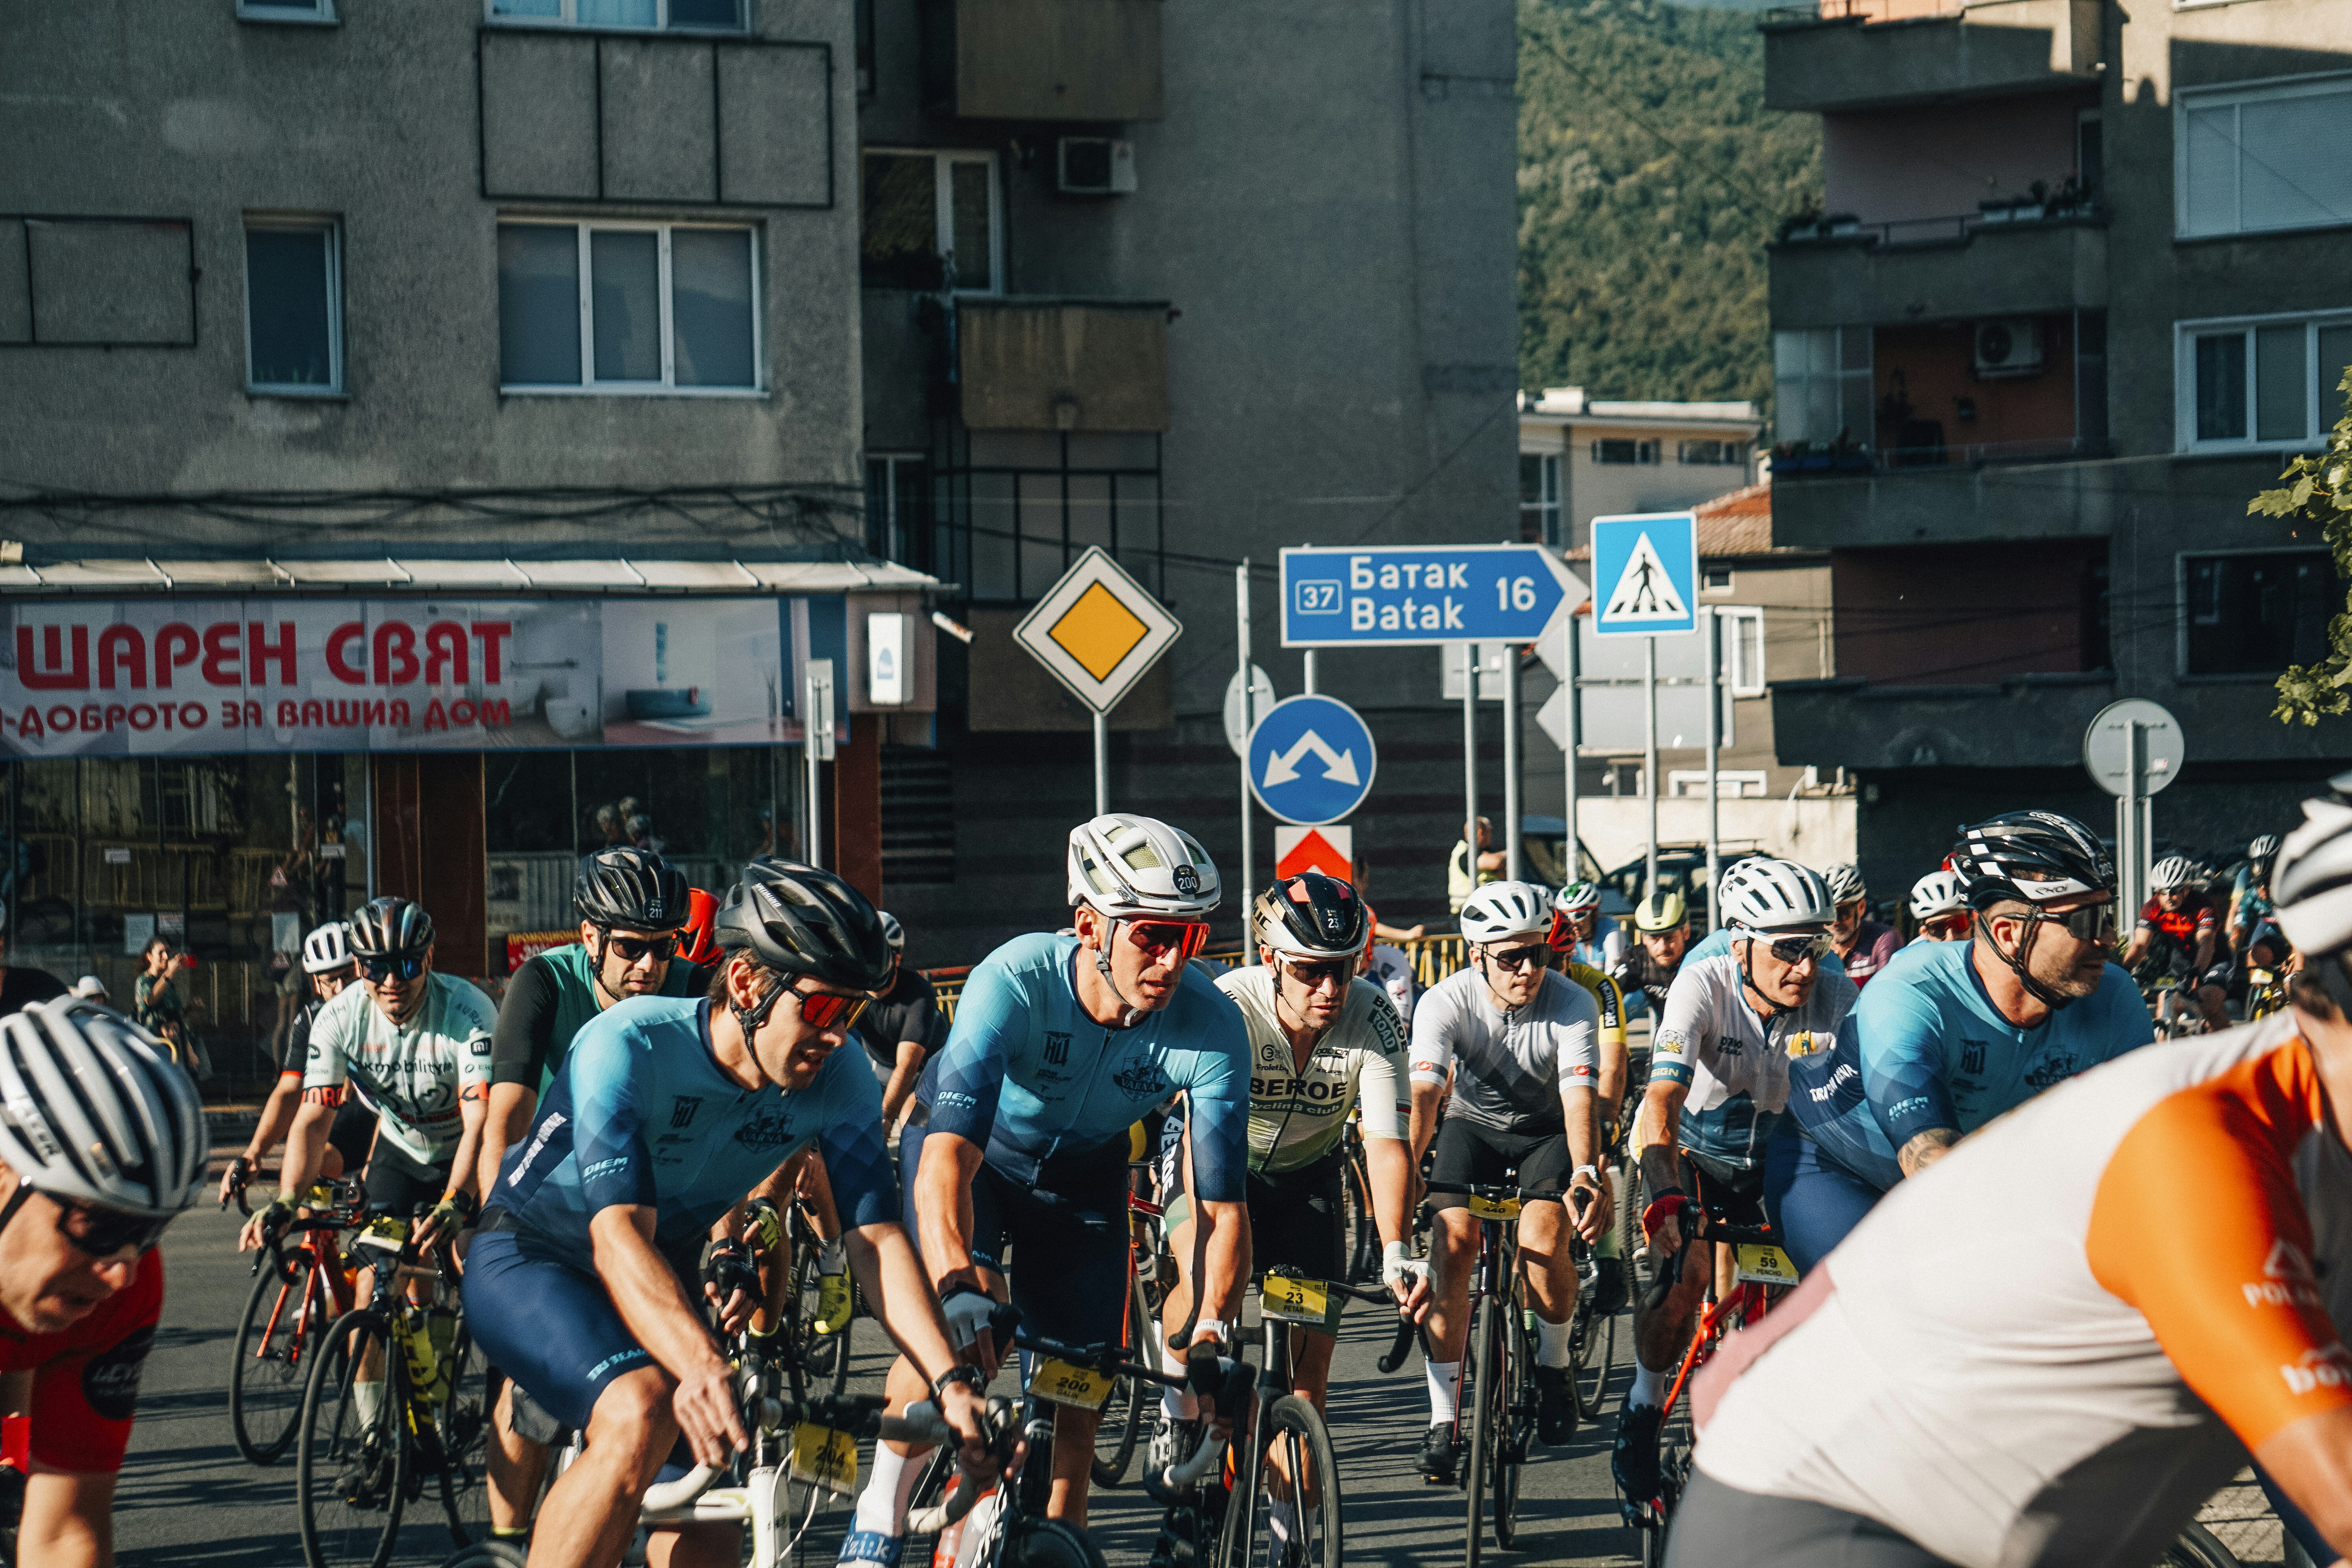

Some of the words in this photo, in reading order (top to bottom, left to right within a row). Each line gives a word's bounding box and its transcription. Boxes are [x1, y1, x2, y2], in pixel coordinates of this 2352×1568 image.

[1350, 556, 1468, 590] Батак
[1304, 586, 1334, 608] 37
[1496, 576, 1536, 611] 16
[1351, 596, 1464, 631] Batak
[17, 622, 297, 689] ШАРЕН
[326, 621, 512, 685] СВЯТ
[0, 703, 207, 739] -ДОБРОТО
[222, 702, 262, 728] ЗА
[278, 700, 410, 727] ВАШИЯ
[424, 698, 511, 731] ДОМ
[1178, 877, 1198, 889] 200
[649, 907, 662, 918] 211
[1328, 918, 1339, 928] 23
[1373, 994, 1408, 1053] BEROE
[1122, 1077, 1155, 1092] VARNA
[1250, 1076, 1348, 1100] BEROE
[938, 1091, 977, 1105] DIEM
[1307, 1104, 1340, 1114] club
[583, 1157, 629, 1178] DIEM
[1760, 1257, 1778, 1267] 59
[1285, 1292, 1303, 1304] 23
[1056, 1377, 1090, 1392] 200
